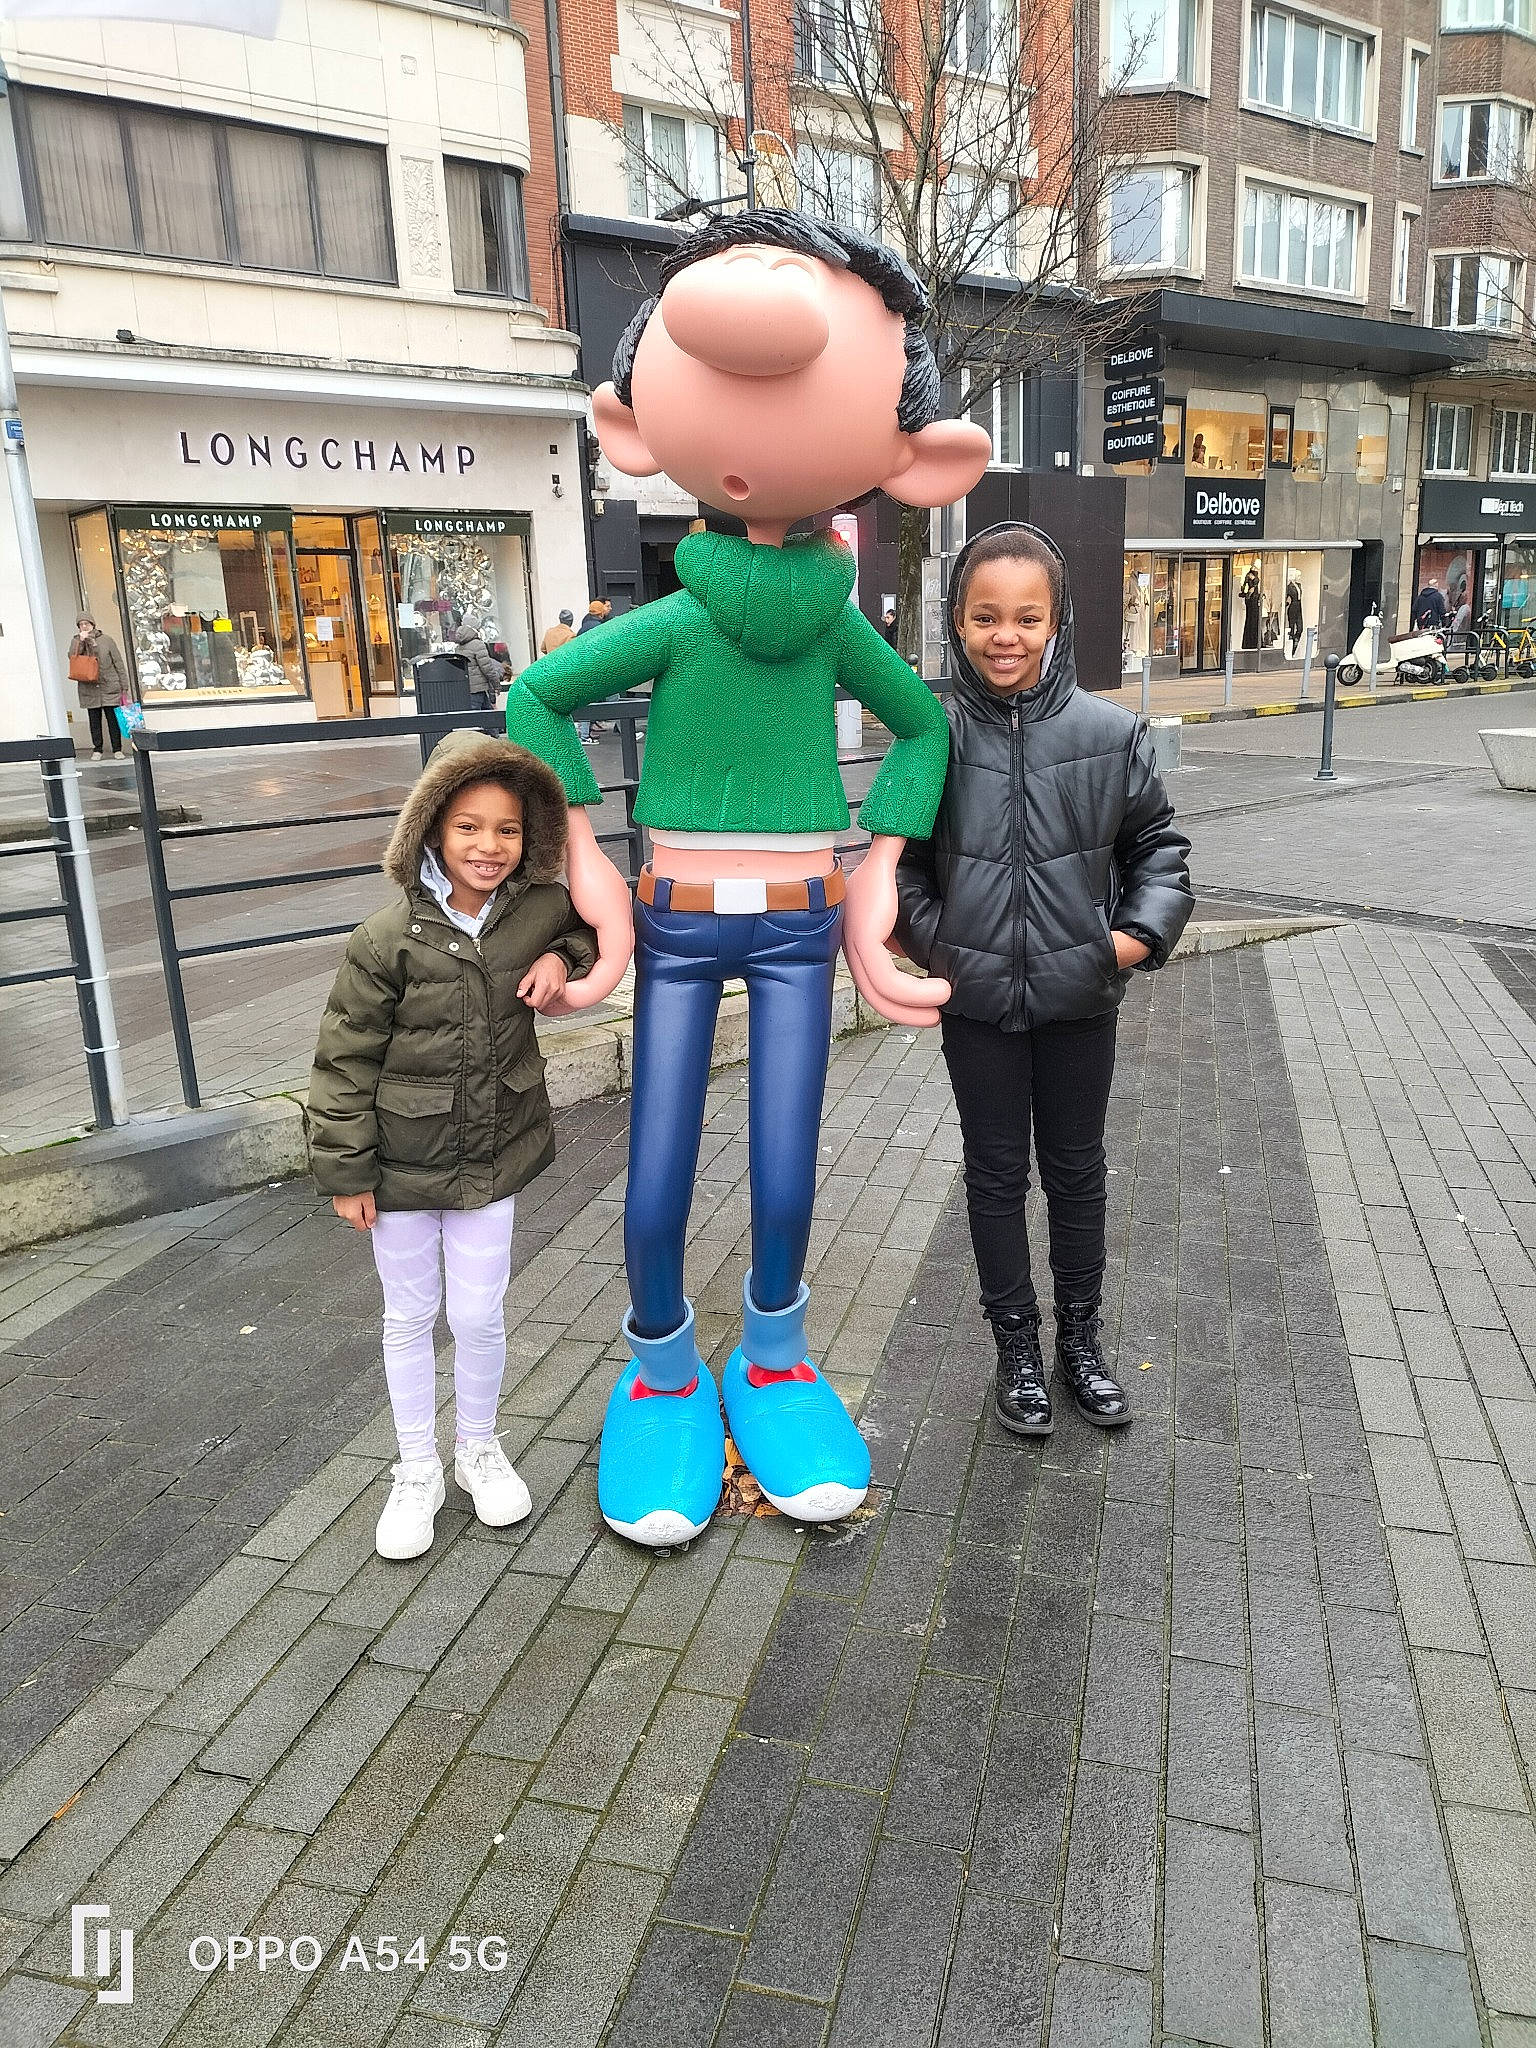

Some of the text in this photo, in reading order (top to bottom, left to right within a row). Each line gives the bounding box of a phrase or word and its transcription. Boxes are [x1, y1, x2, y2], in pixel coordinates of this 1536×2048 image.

[1110, 347, 1154, 366] DELBOVE
[1111, 385, 1151, 401] COIFFURE
[1106, 397, 1156, 415] ESTHETIQUE
[1107, 432, 1155, 450] BOUTIQUE
[179, 431, 476, 475] LONGCHAMP
[1196, 491, 1260, 516] Delbove
[150, 513, 262, 528] LONGCHAMP
[415, 519, 506, 532] LONGCHAMP
